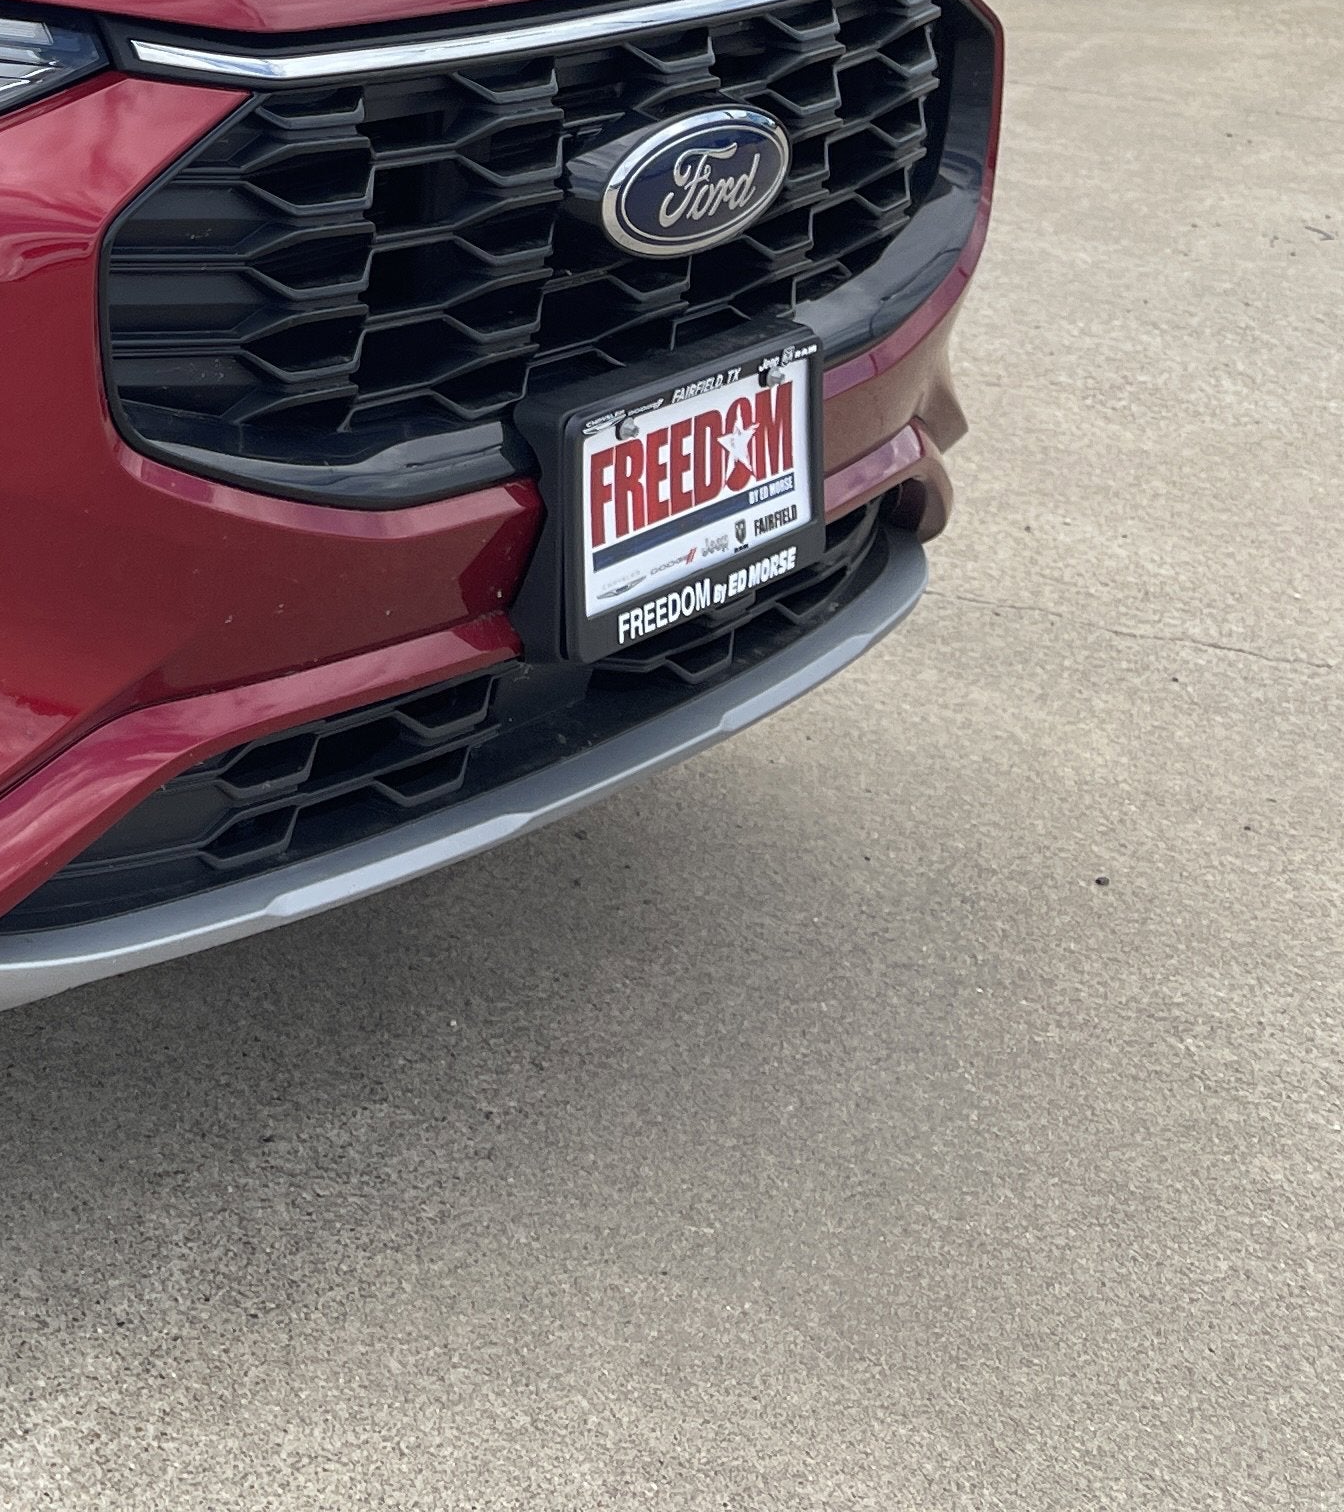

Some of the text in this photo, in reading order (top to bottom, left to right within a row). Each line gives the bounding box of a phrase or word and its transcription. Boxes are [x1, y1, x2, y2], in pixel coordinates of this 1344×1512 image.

[658, 143, 761, 228] Ford
[727, 367, 742, 383] TX
[590, 381, 794, 549] FREEDOM
[754, 504, 798, 537] FAIRFIELD
[618, 577, 711, 645] FREEDOM
[728, 569, 748, 597] ED
[748, 546, 798, 589] MORSE
